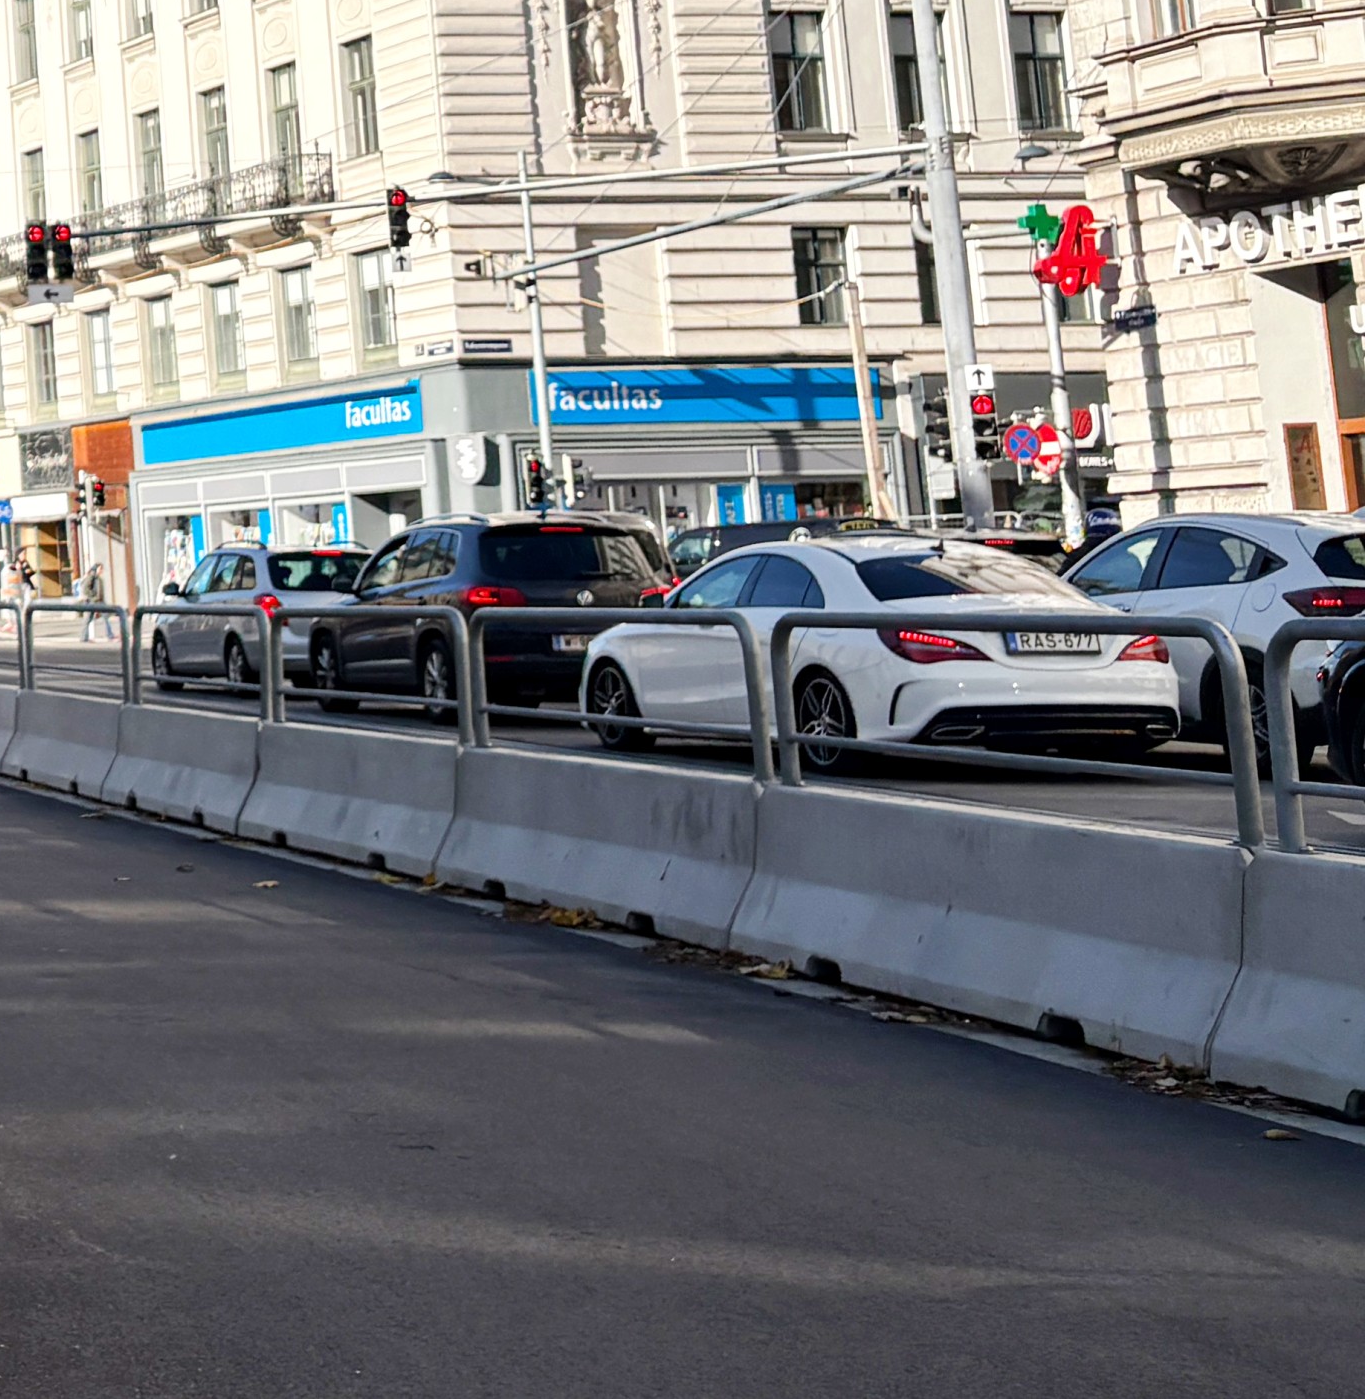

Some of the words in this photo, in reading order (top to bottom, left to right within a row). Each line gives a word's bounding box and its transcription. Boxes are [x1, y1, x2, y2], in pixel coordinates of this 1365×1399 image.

[1173, 183, 1365, 275] APOTHE
[549, 381, 663, 411] facultas
[345, 397, 412, 429] facultas
